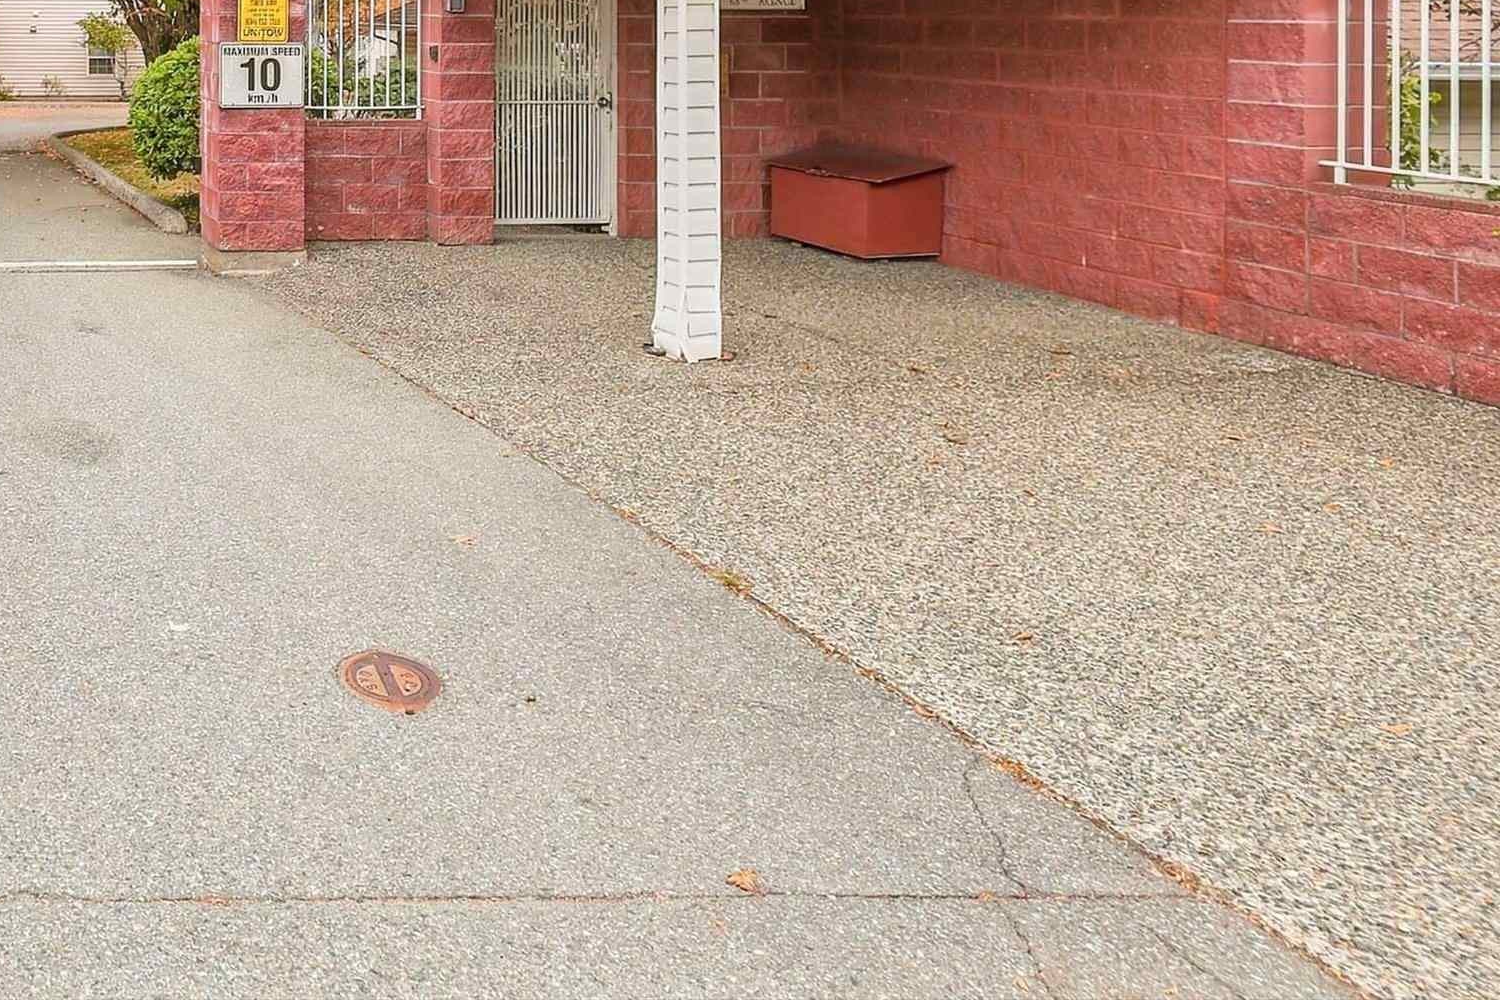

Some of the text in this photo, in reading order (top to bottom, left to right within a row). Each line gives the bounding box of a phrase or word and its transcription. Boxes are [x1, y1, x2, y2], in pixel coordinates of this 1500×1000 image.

[223, 47, 301, 56] MAXIMUM SPEED
[240, 57, 281, 91] 10
